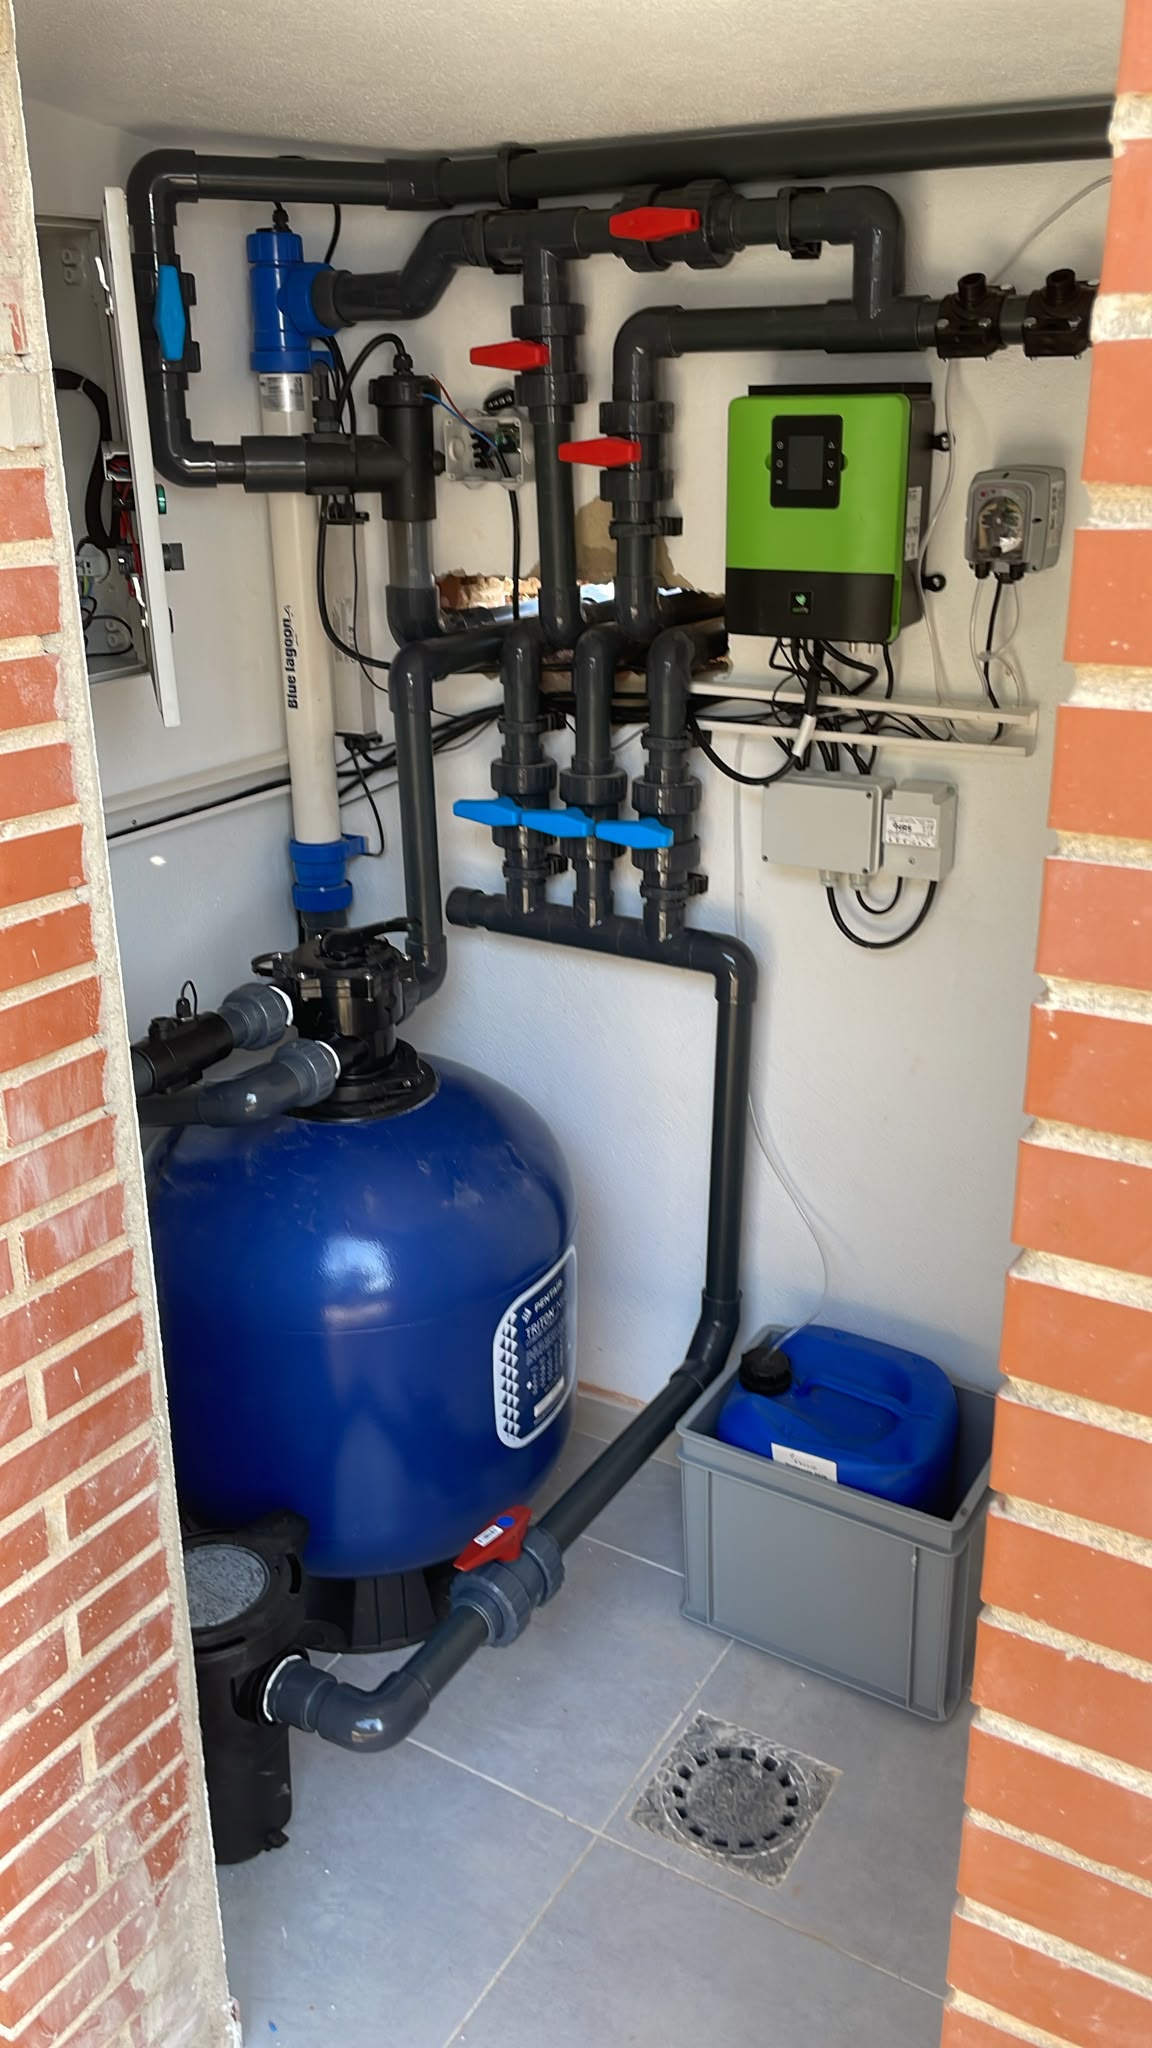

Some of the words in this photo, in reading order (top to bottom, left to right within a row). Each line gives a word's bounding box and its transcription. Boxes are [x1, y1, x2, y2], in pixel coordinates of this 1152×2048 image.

[283, 618, 297, 672] lagoon
[287, 675, 298, 709] Blue
[534, 1279, 563, 1313] PENTAIR
[525, 1306, 555, 1340] TRITON
